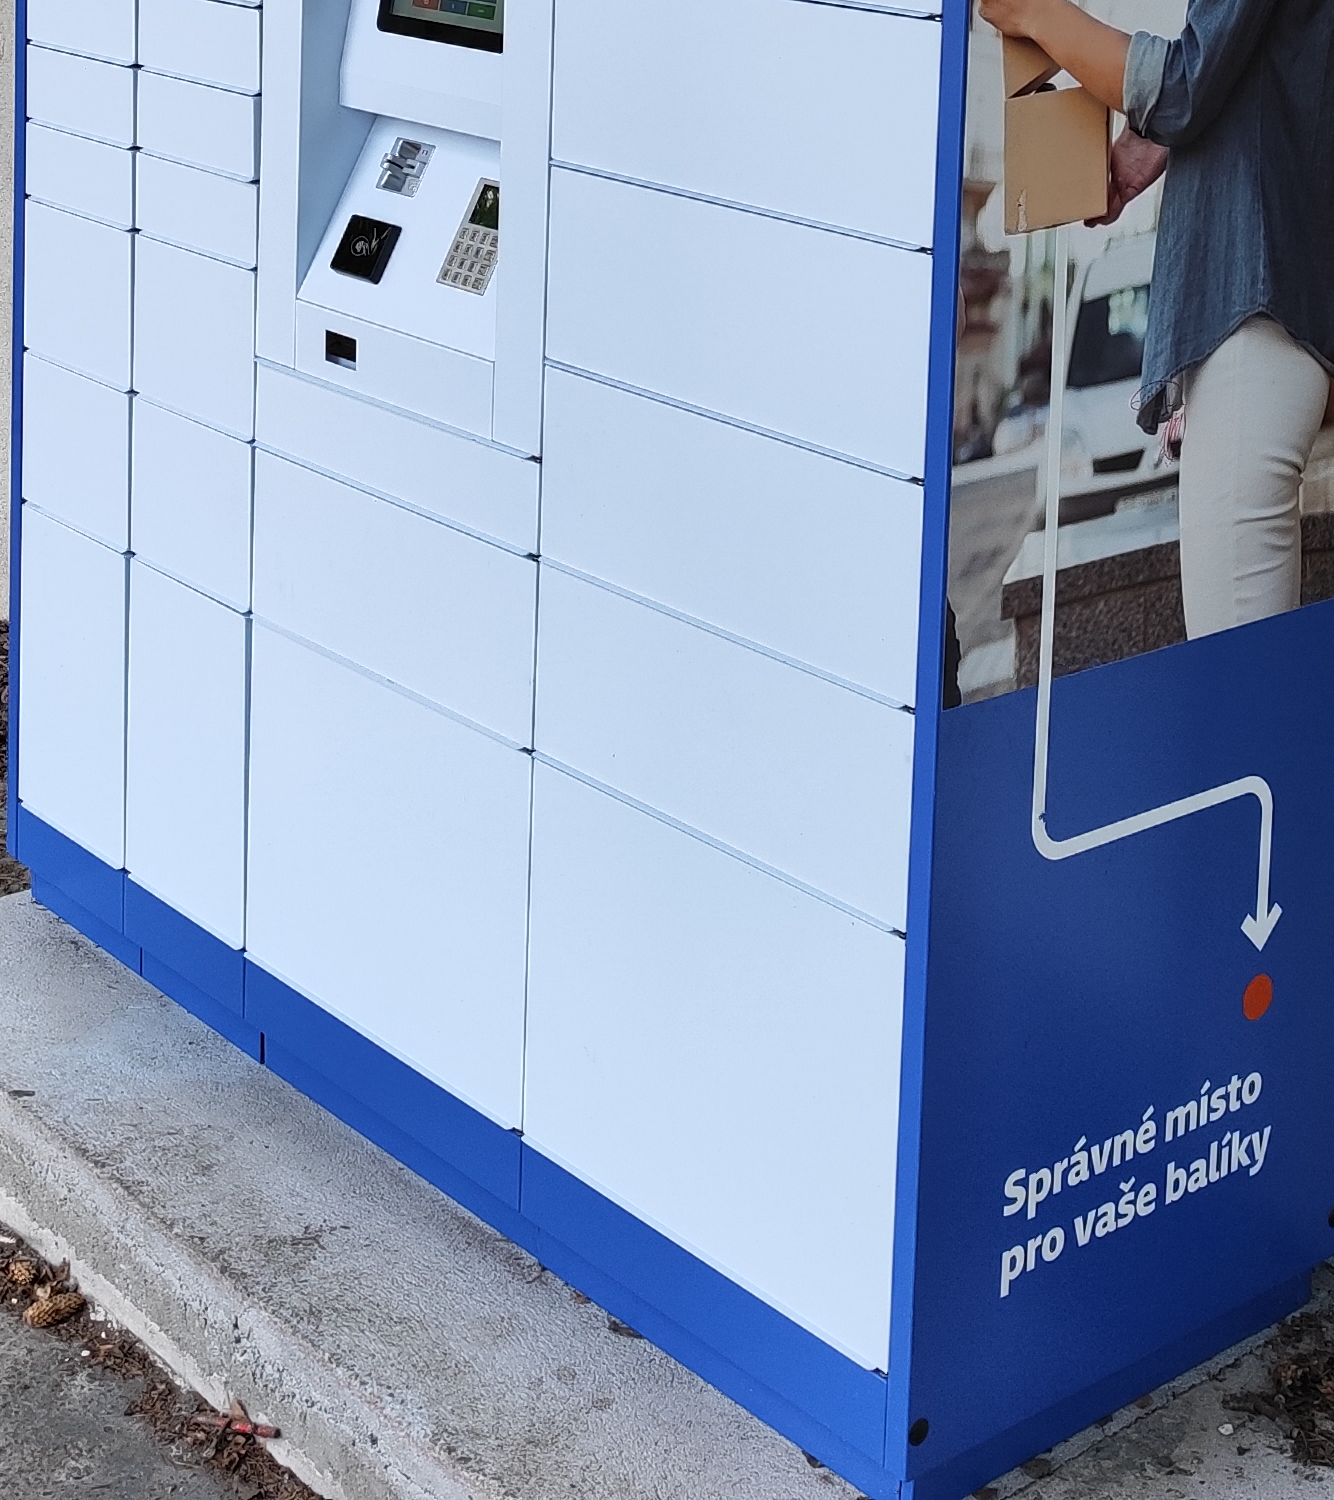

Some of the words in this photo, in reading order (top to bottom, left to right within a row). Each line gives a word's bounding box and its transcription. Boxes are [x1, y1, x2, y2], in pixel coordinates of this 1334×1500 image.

[1000, 1226, 1065, 1299] pro
[1073, 1176, 1157, 1248] vaše
[1165, 1125, 1273, 1205] balíky
[1003, 1104, 1157, 1221] Správné
[1164, 1071, 1263, 1143] místo
